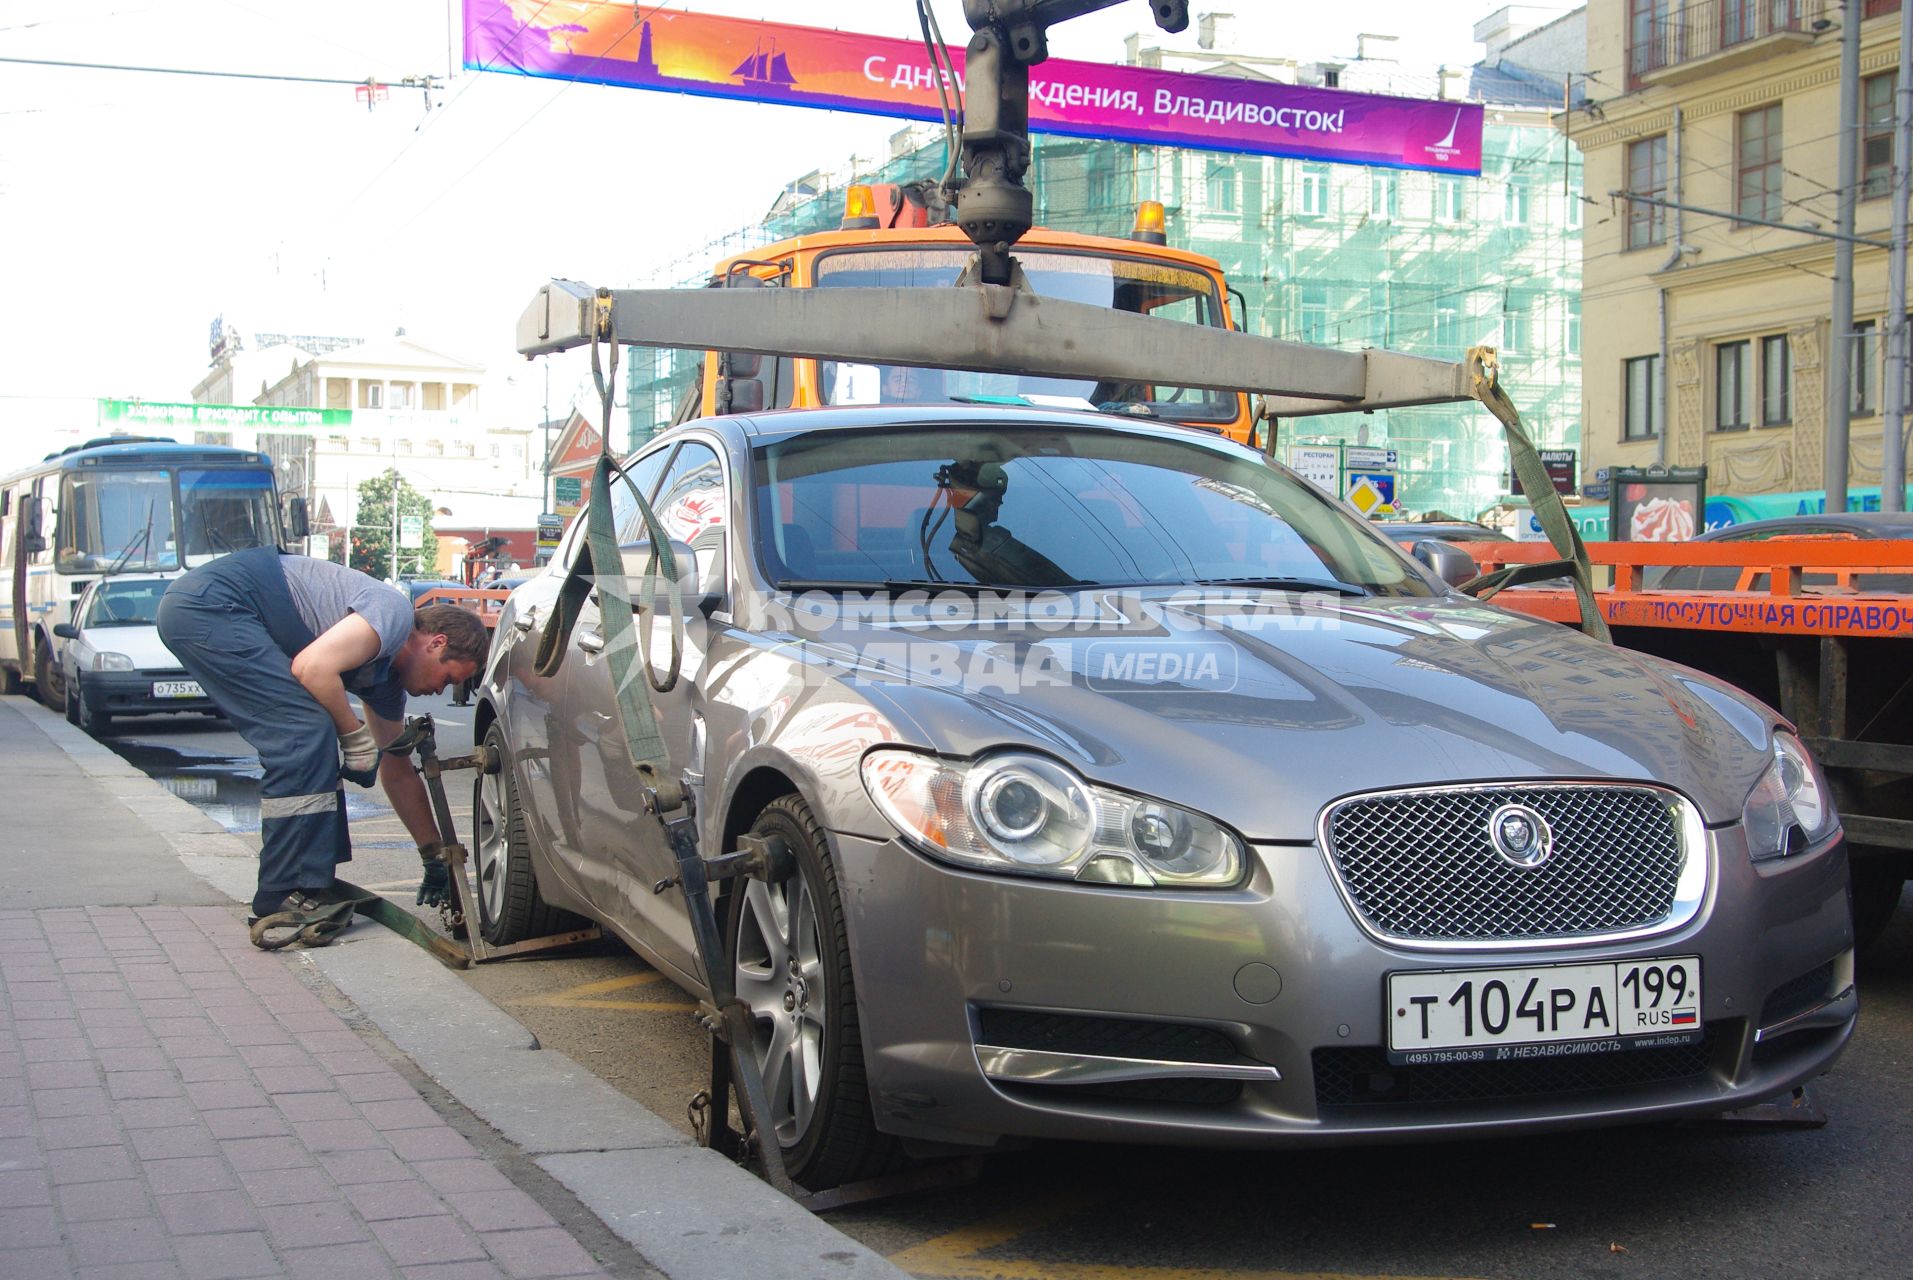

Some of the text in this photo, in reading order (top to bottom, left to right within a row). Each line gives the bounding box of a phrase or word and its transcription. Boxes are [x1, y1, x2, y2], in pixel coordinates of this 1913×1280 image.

[863, 56, 887, 82] С
[1154, 88, 1344, 133] Владивосток!
[196, 407, 259, 422] ПРИХОДИТ
[271, 411, 323, 424] ОПЫТОМ
[1541, 451, 1573, 462] ВАЛЮТЫ
[1410, 964, 1688, 1039] Т104РА 199
[1637, 1010, 1671, 1026] RUS
[1513, 1040, 1621, 1059] НЕЗАВИСИМОСТЬ
[1634, 1034, 1691, 1048] www.indep.ru
